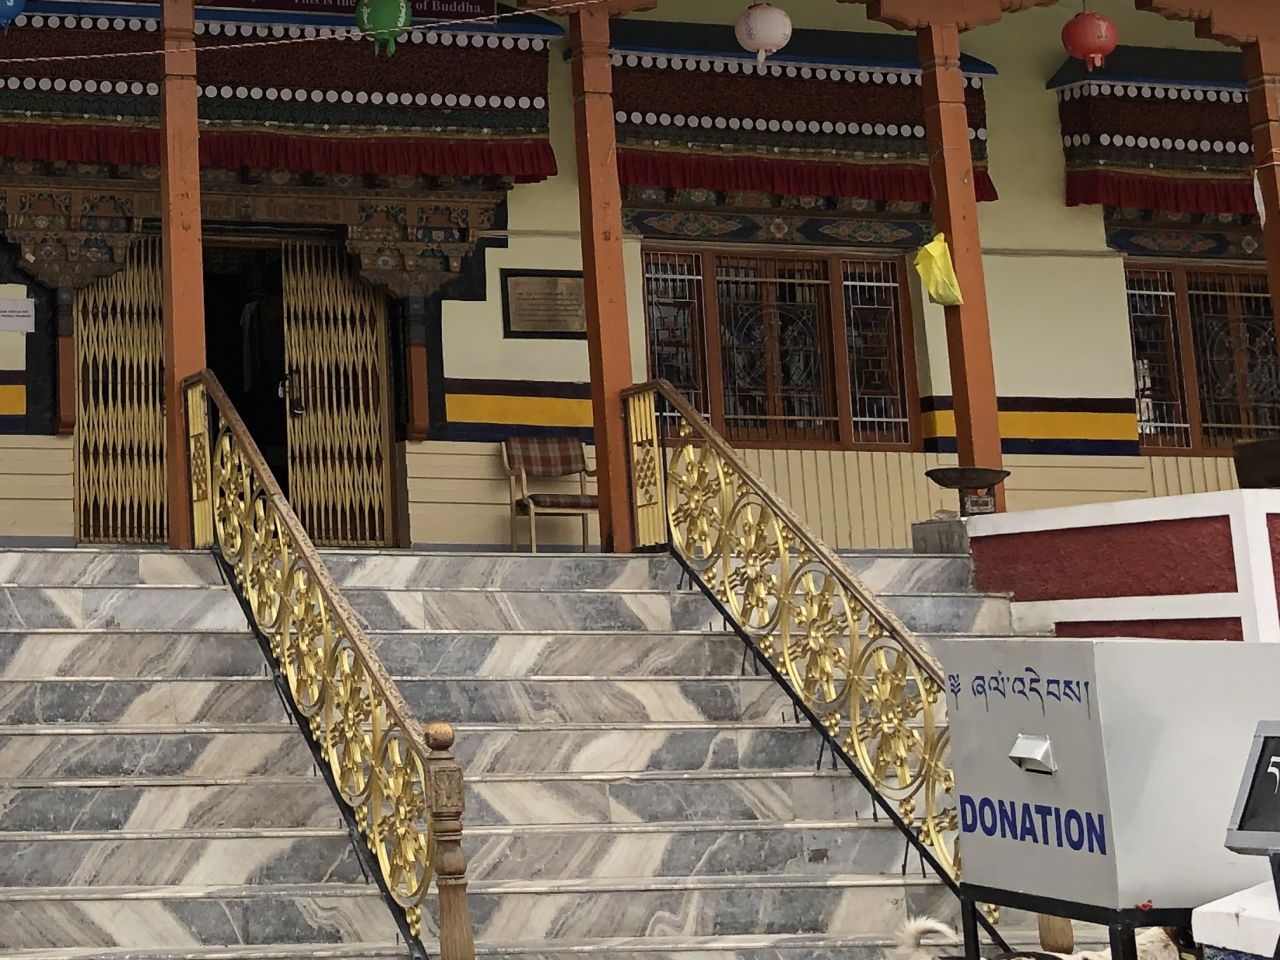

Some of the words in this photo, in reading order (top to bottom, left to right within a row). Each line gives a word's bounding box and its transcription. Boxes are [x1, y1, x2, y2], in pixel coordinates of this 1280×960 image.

[415, 0, 428, 11] of
[432, 0, 485, 14] Buddha.
[960, 794, 1107, 856] DONATION
